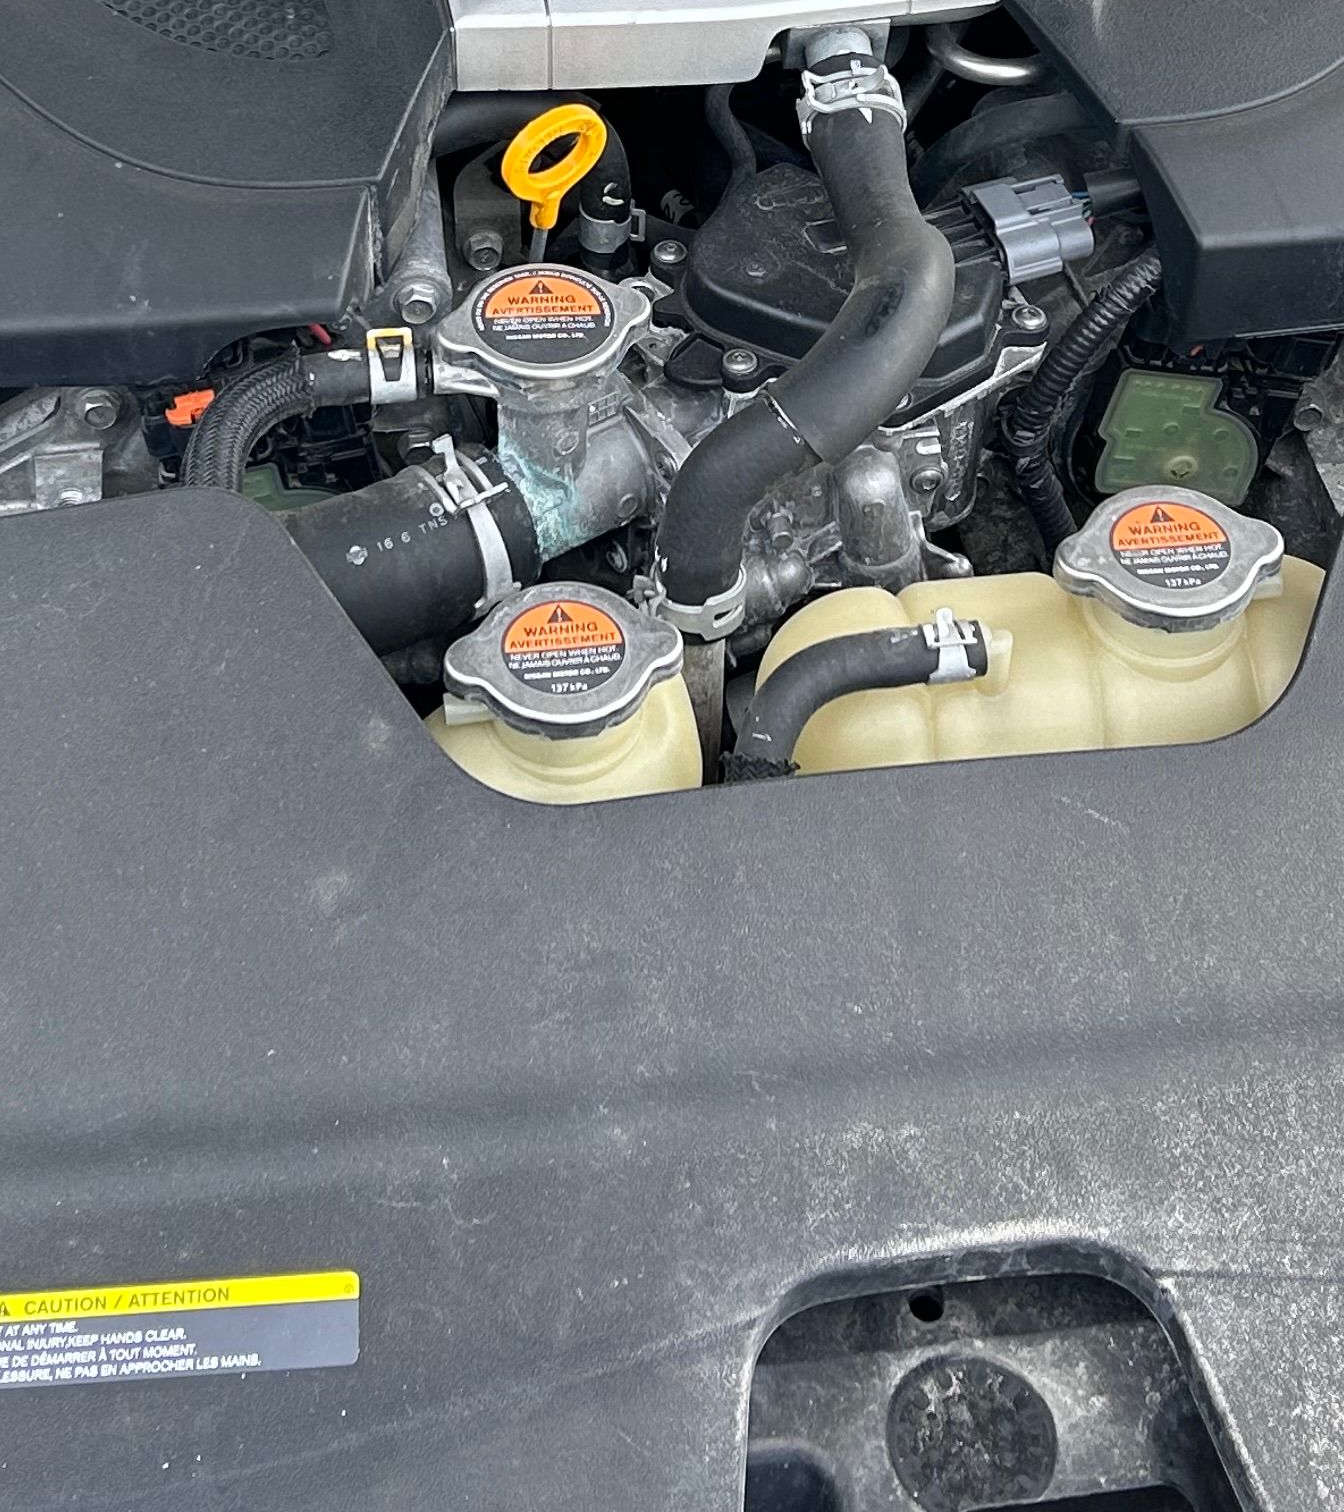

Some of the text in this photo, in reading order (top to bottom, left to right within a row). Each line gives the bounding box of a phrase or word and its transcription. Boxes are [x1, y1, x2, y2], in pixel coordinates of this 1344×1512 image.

[507, 295, 576, 305] WARNING
[492, 305, 594, 315] AVERTISSEMENT
[376, 516, 448, 552] 16 6 TNS
[1128, 521, 1201, 535] WARNING
[1118, 531, 1219, 547] AVERTISSEMENT
[524, 621, 598, 637] WARNING
[510, 632, 616, 649] AVERTISSEMENT
[23, 1287, 231, 1316] CAUTION / ATTENTION
[5, 1326, 19, 1338] AT
[22, 1323, 47, 1337] ANY
[49, 1320, 79, 1335] TIME.
[101, 1330, 143, 1345] HANDS
[145, 1327, 187, 1341] CLEAR.
[11, 1354, 28, 1367] DE
[31, 1349, 97, 1366] DÉMARRER
[99, 1346, 109, 1361] À
[110, 1346, 142, 1359] TOUT
[143, 1343, 198, 1359] MOMENT.
[55, 1367, 73, 1380] NE
[74, 1364, 99, 1378] PAS
[100, 1363, 117, 1377] EN
[118, 1359, 195, 1376] APPROCHER
[196, 1355, 219, 1370] LES
[220, 1352, 262, 1368] MAINS.
